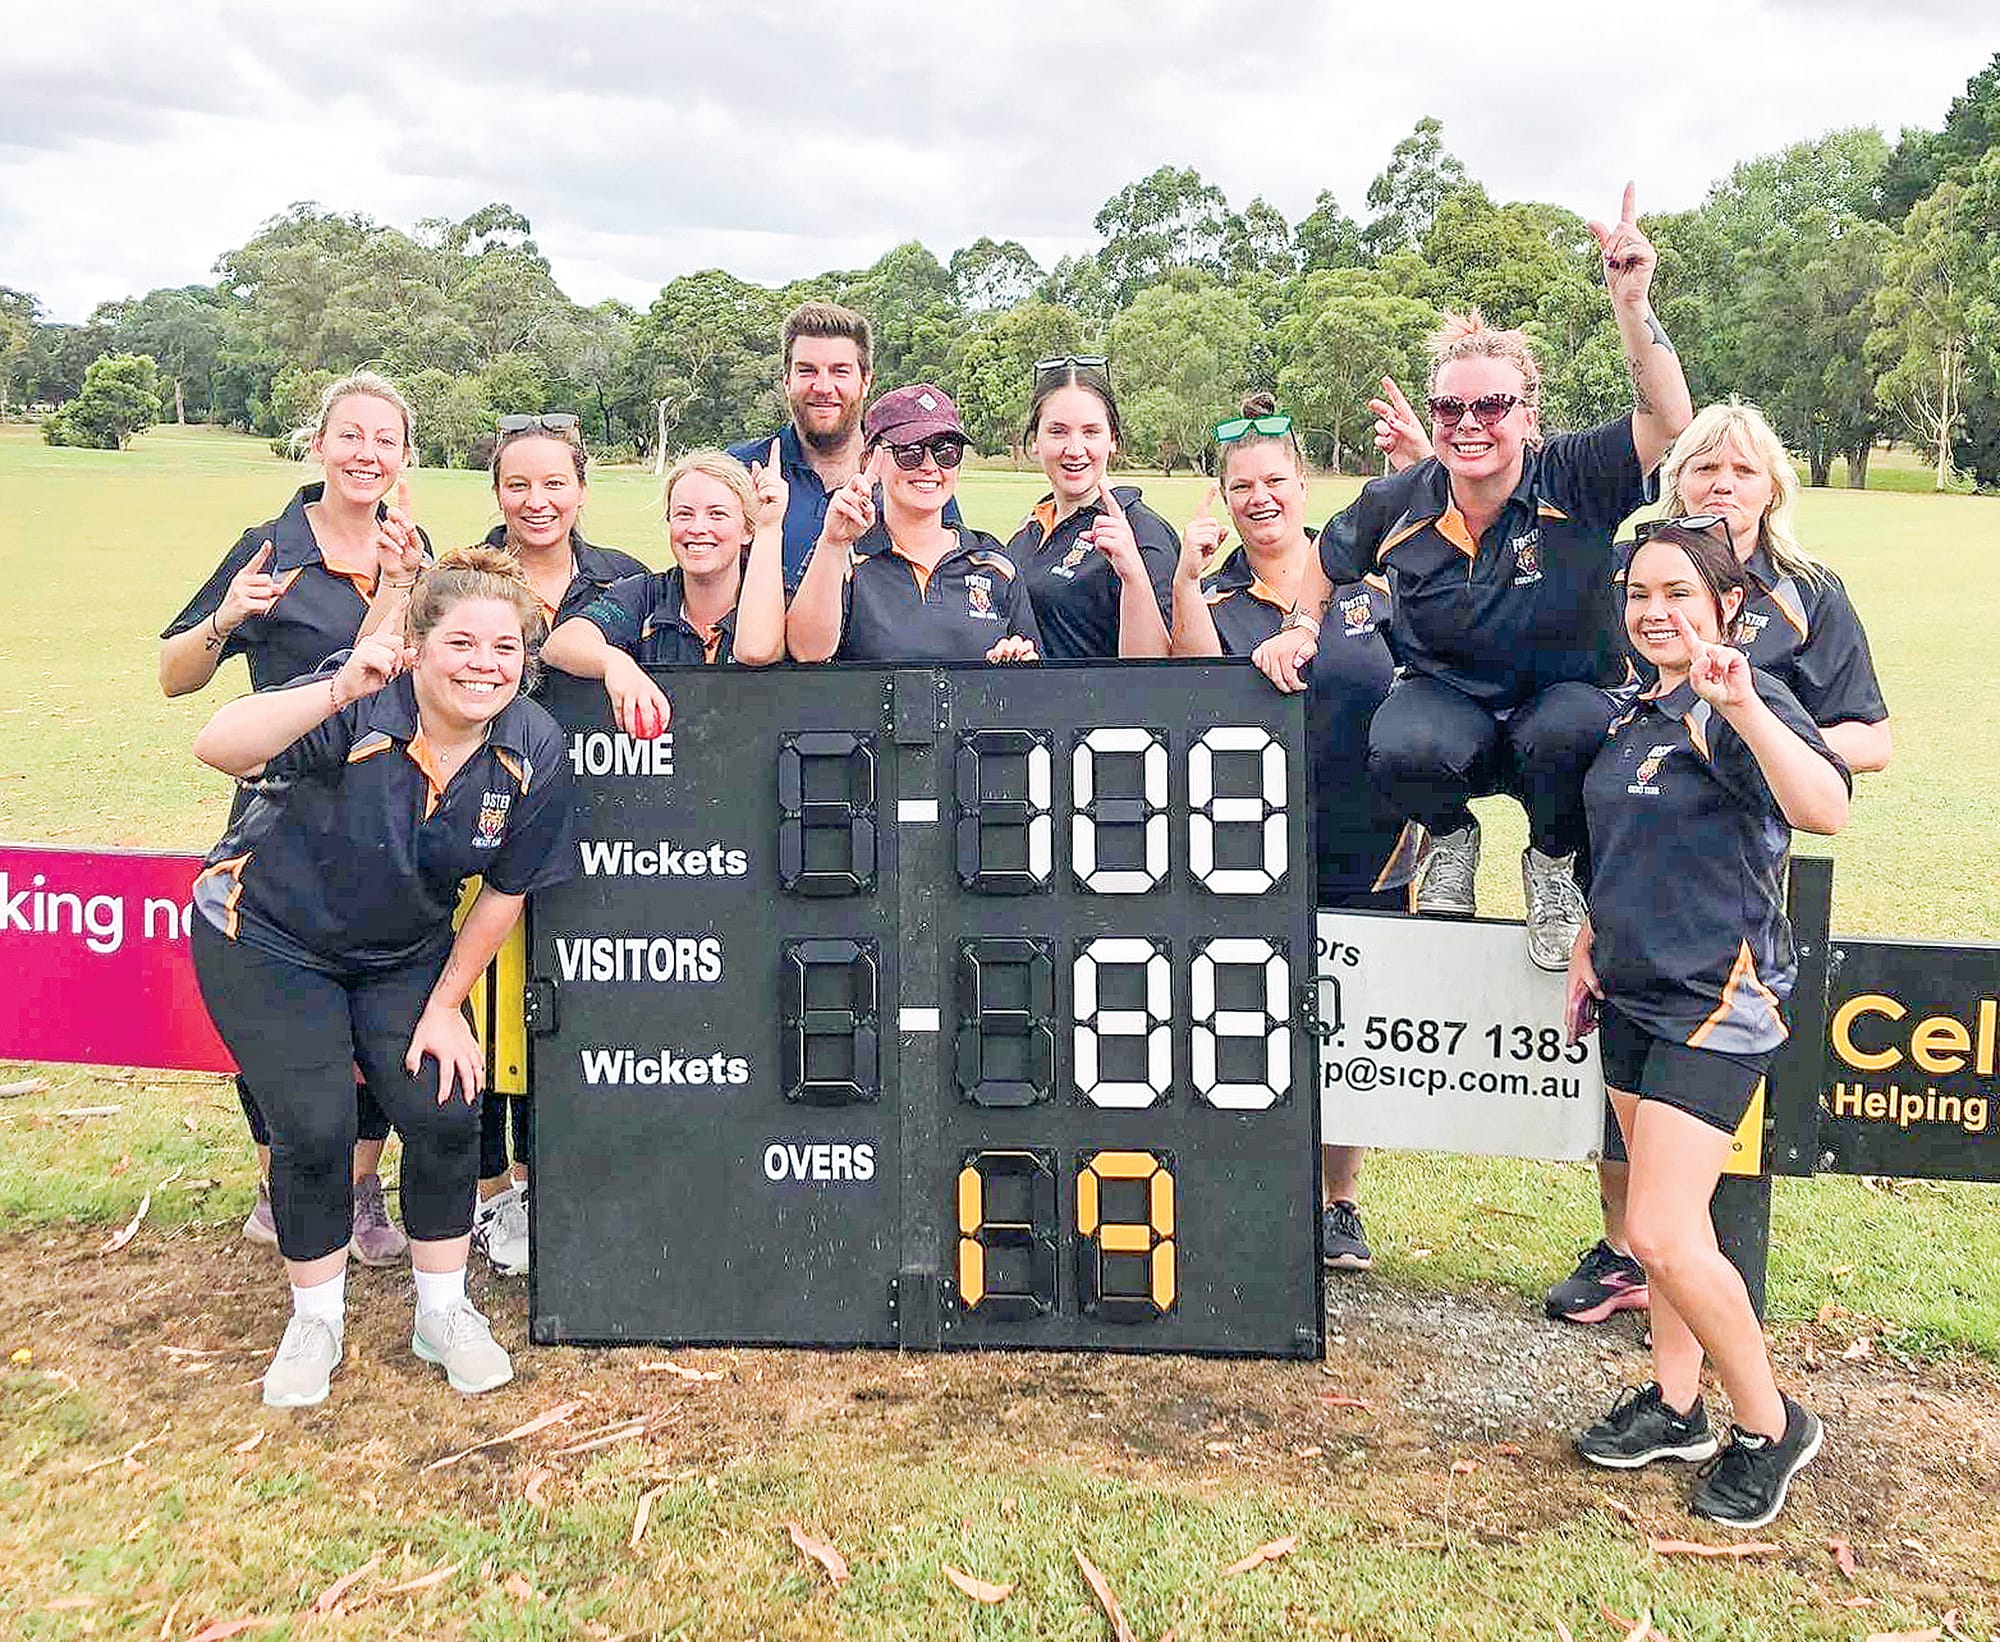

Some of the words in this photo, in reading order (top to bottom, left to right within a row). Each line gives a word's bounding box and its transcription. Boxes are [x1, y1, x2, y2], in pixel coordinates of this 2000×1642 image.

[569, 732, 674, 775] HOME
[579, 841, 748, 876] Wickets
[0, 871, 124, 954] king
[556, 938, 722, 982] VISITORS
[1073, 937, 1292, 1109] 88
[1364, 1016, 1468, 1055] 5687
[1485, 1024, 1588, 1064] 1385
[1831, 994, 1998, 1075] Cel
[581, 1050, 749, 1084] Wickets
[1320, 1057, 1580, 1099] p@sicp.com.au
[1835, 1083, 1988, 1131] Helping
[763, 1144, 875, 1180] OVERS
[958, 1150, 1176, 1312] 19
